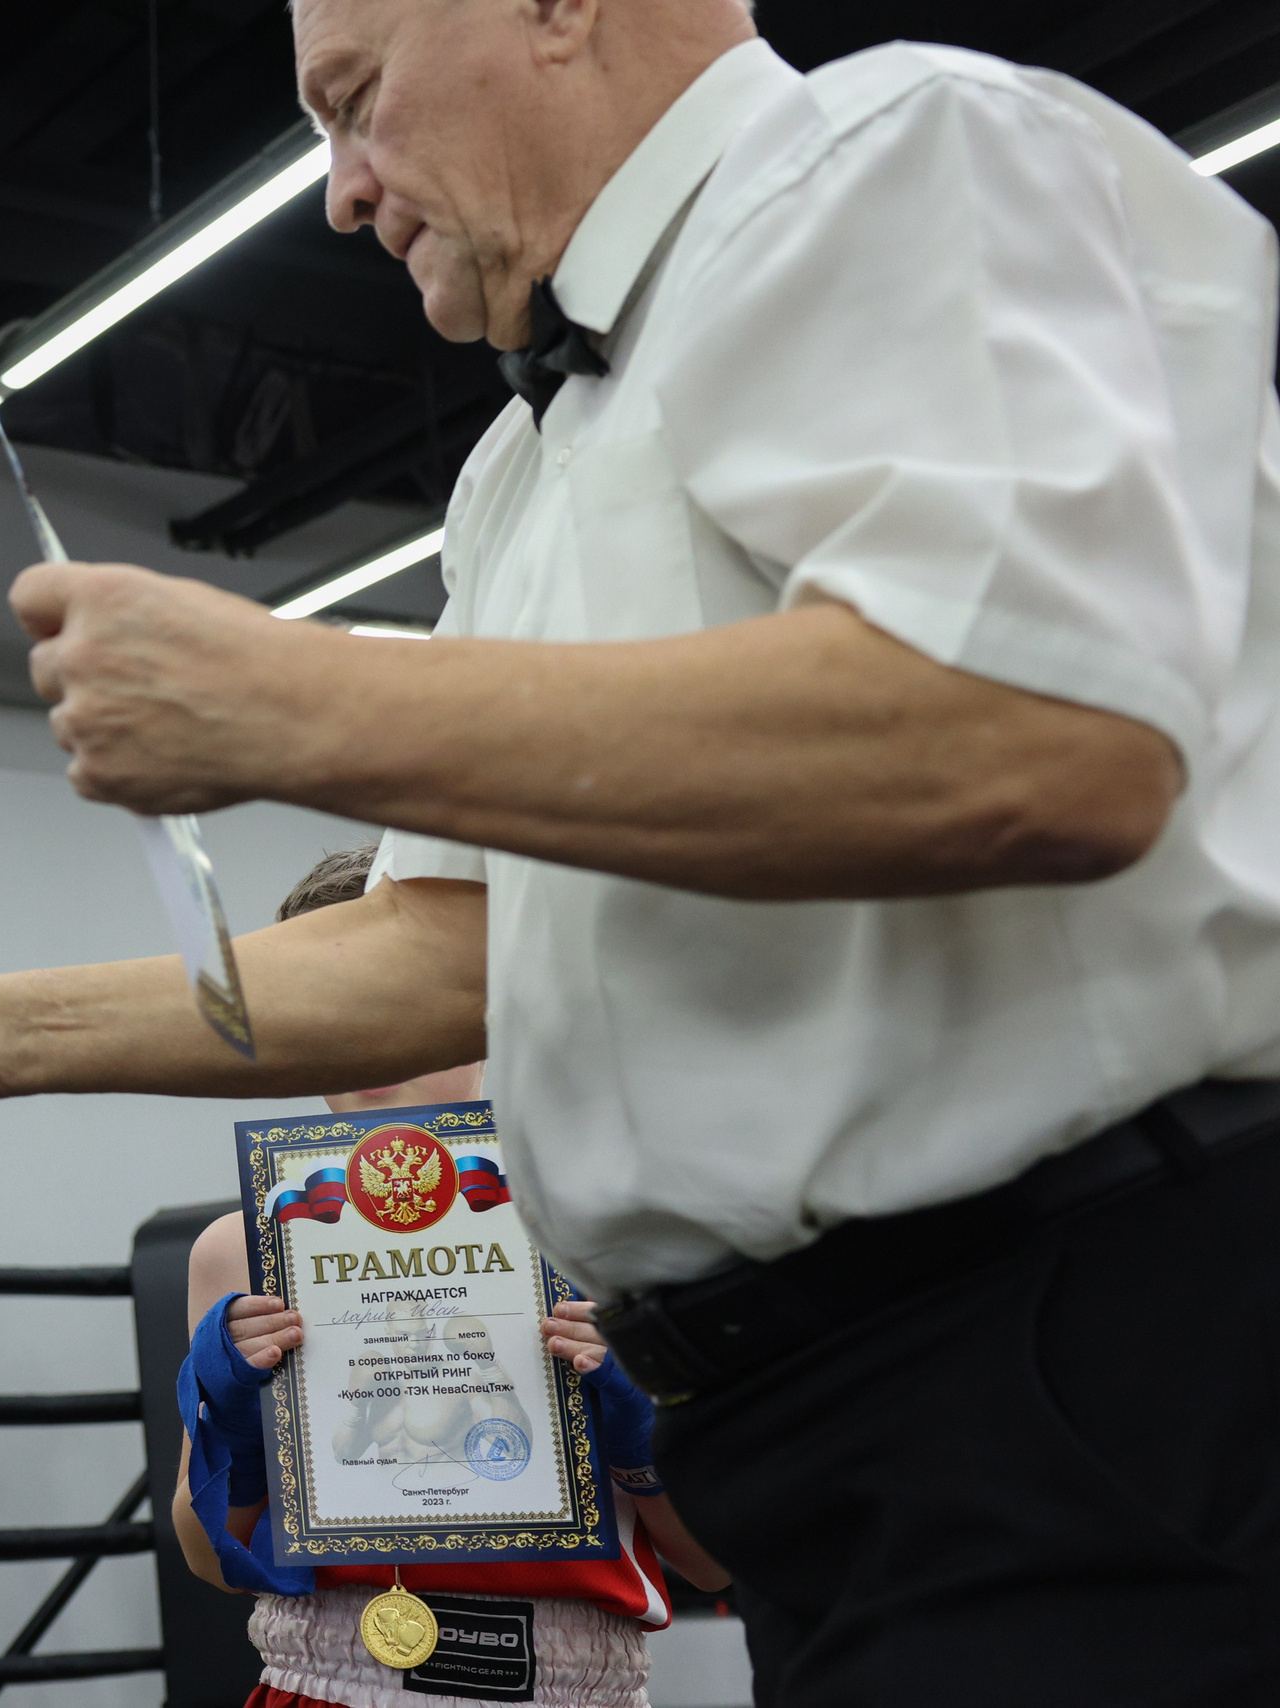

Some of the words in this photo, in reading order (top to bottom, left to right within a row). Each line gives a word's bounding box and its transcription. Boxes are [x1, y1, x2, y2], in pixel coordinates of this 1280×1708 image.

[309, 1242, 515, 1285] ГРАМОТА
[361, 1286, 468, 1304] НАГРАЖДАЕТСЯ
[409, 1299, 467, 1318] Иван
[363, 1333, 410, 1345] занявший
[458, 1330, 486, 1340] место
[348, 1358, 356, 1367] в
[358, 1351, 445, 1367] соревнованиях
[446, 1352, 461, 1362] по
[463, 1349, 496, 1362] боксу
[373, 1366, 440, 1382] ОТКРЫТЫЙ
[442, 1366, 473, 1379] РИНГ
[337, 1388, 375, 1401] «Кубок
[376, 1387, 402, 1398] ООО
[404, 1385, 430, 1396] «ТЭК
[432, 1382, 515, 1396] НеваСпецТяж»
[342, 1457, 375, 1467] Главный
[376, 1457, 398, 1467] судья
[402, 1487, 469, 1498] Санкт-Петербург
[422, 1498, 445, 1506] 2023
[438, 1627, 519, 1648] OYBO
[434, 1662, 478, 1674] FIGHTING
[478, 1668, 504, 1676] GEAR
